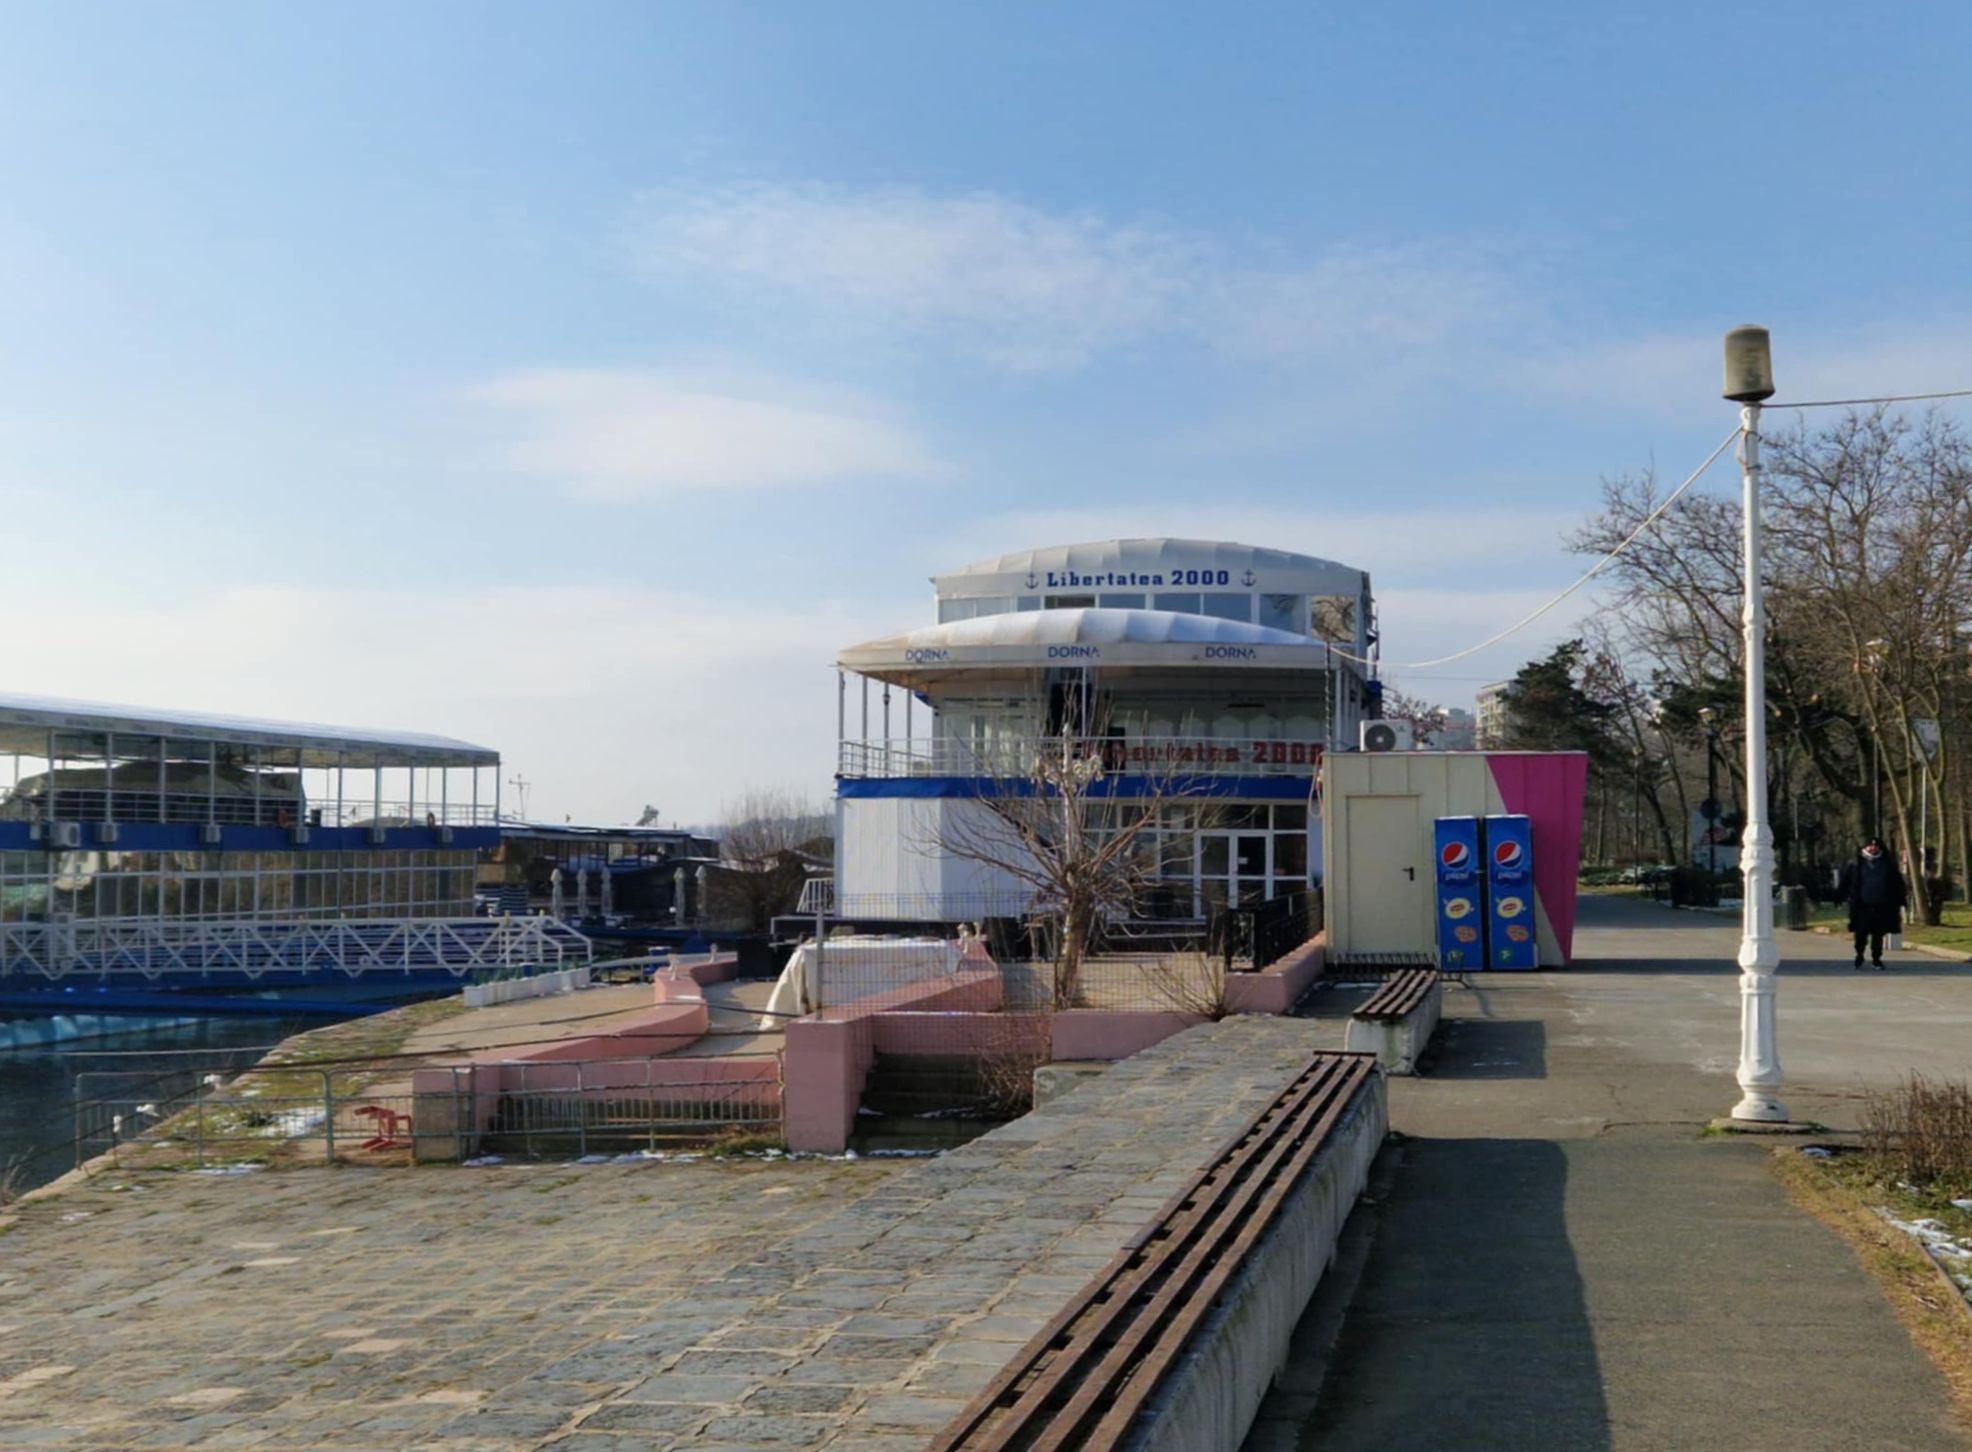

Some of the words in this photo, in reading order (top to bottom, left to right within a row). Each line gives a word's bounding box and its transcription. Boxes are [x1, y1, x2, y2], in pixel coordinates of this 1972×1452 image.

[1047, 571, 1163, 587] Libertatea
[1171, 570, 1229, 585] 2000
[905, 649, 948, 662] DORNA
[1048, 646, 1100, 658] DORNA
[1205, 646, 1256, 659] DORNA
